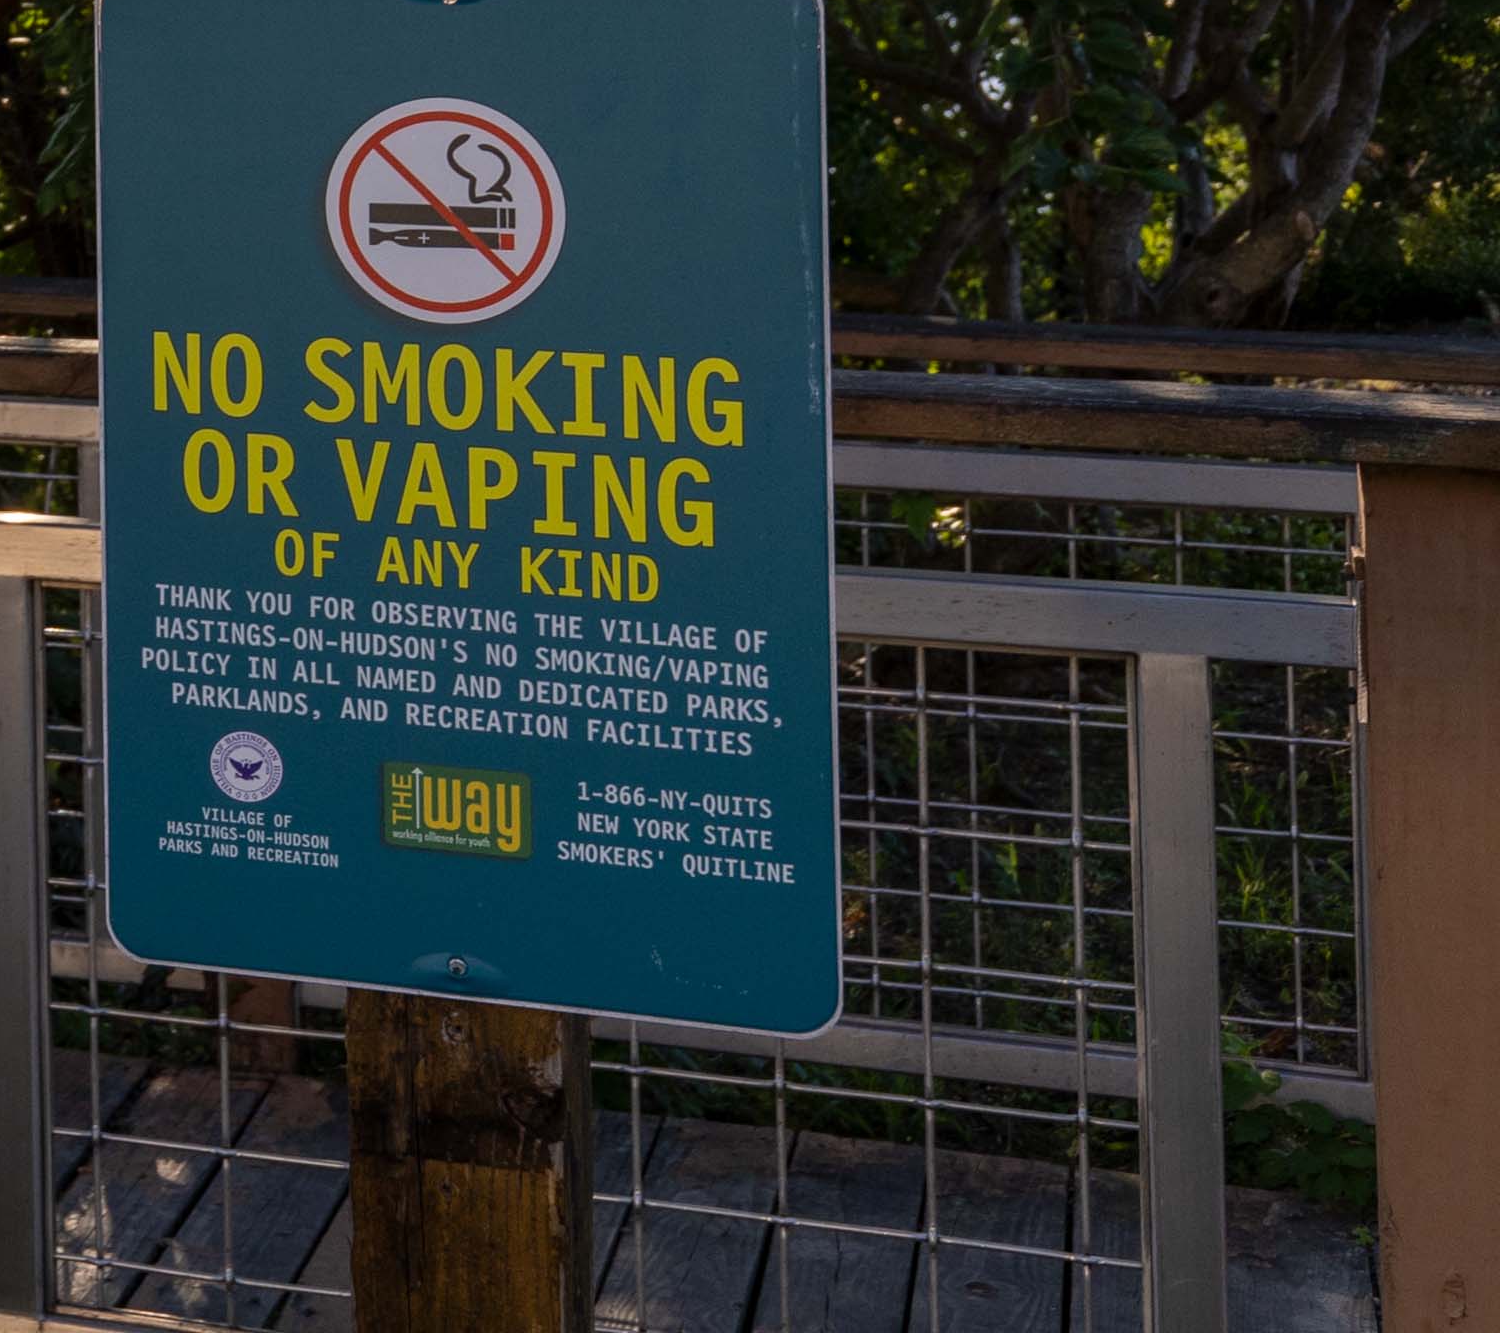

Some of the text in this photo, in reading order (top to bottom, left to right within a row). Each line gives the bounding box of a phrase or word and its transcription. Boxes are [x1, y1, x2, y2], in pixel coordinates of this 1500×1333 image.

[153, 332, 744, 447] NO SMOKING
[183, 430, 715, 548] OR VAPING
[275, 529, 659, 603] OF ANY KIND
[155, 583, 768, 653] THANK YOU FOR OBSERVING THE VILLAGE OF
[155, 616, 769, 689] HASTINGS-ON-HUDSON'S NO SMOKING/VAPING
[141, 647, 783, 729] POLICY IN ALL NAMED AND DEDICATED PARKS,
[171, 682, 753, 756] PARKLANDS, AND RECREATION FACILITIES
[225, 734, 267, 747] HASTINGS
[201, 806, 293, 828] VILLAGE OF
[391, 773, 521, 853] THE way
[577, 782, 773, 819] 1-866-NY-QUITS
[159, 837, 339, 868] PARKS AND RECREATION
[167, 821, 330, 850] HASTINGS-ON-HUDSON
[392, 829, 491, 848] working alliance for youth
[577, 812, 773, 850] NEW YORK STATE
[557, 840, 795, 884] SMOKERS' QUITLINE
